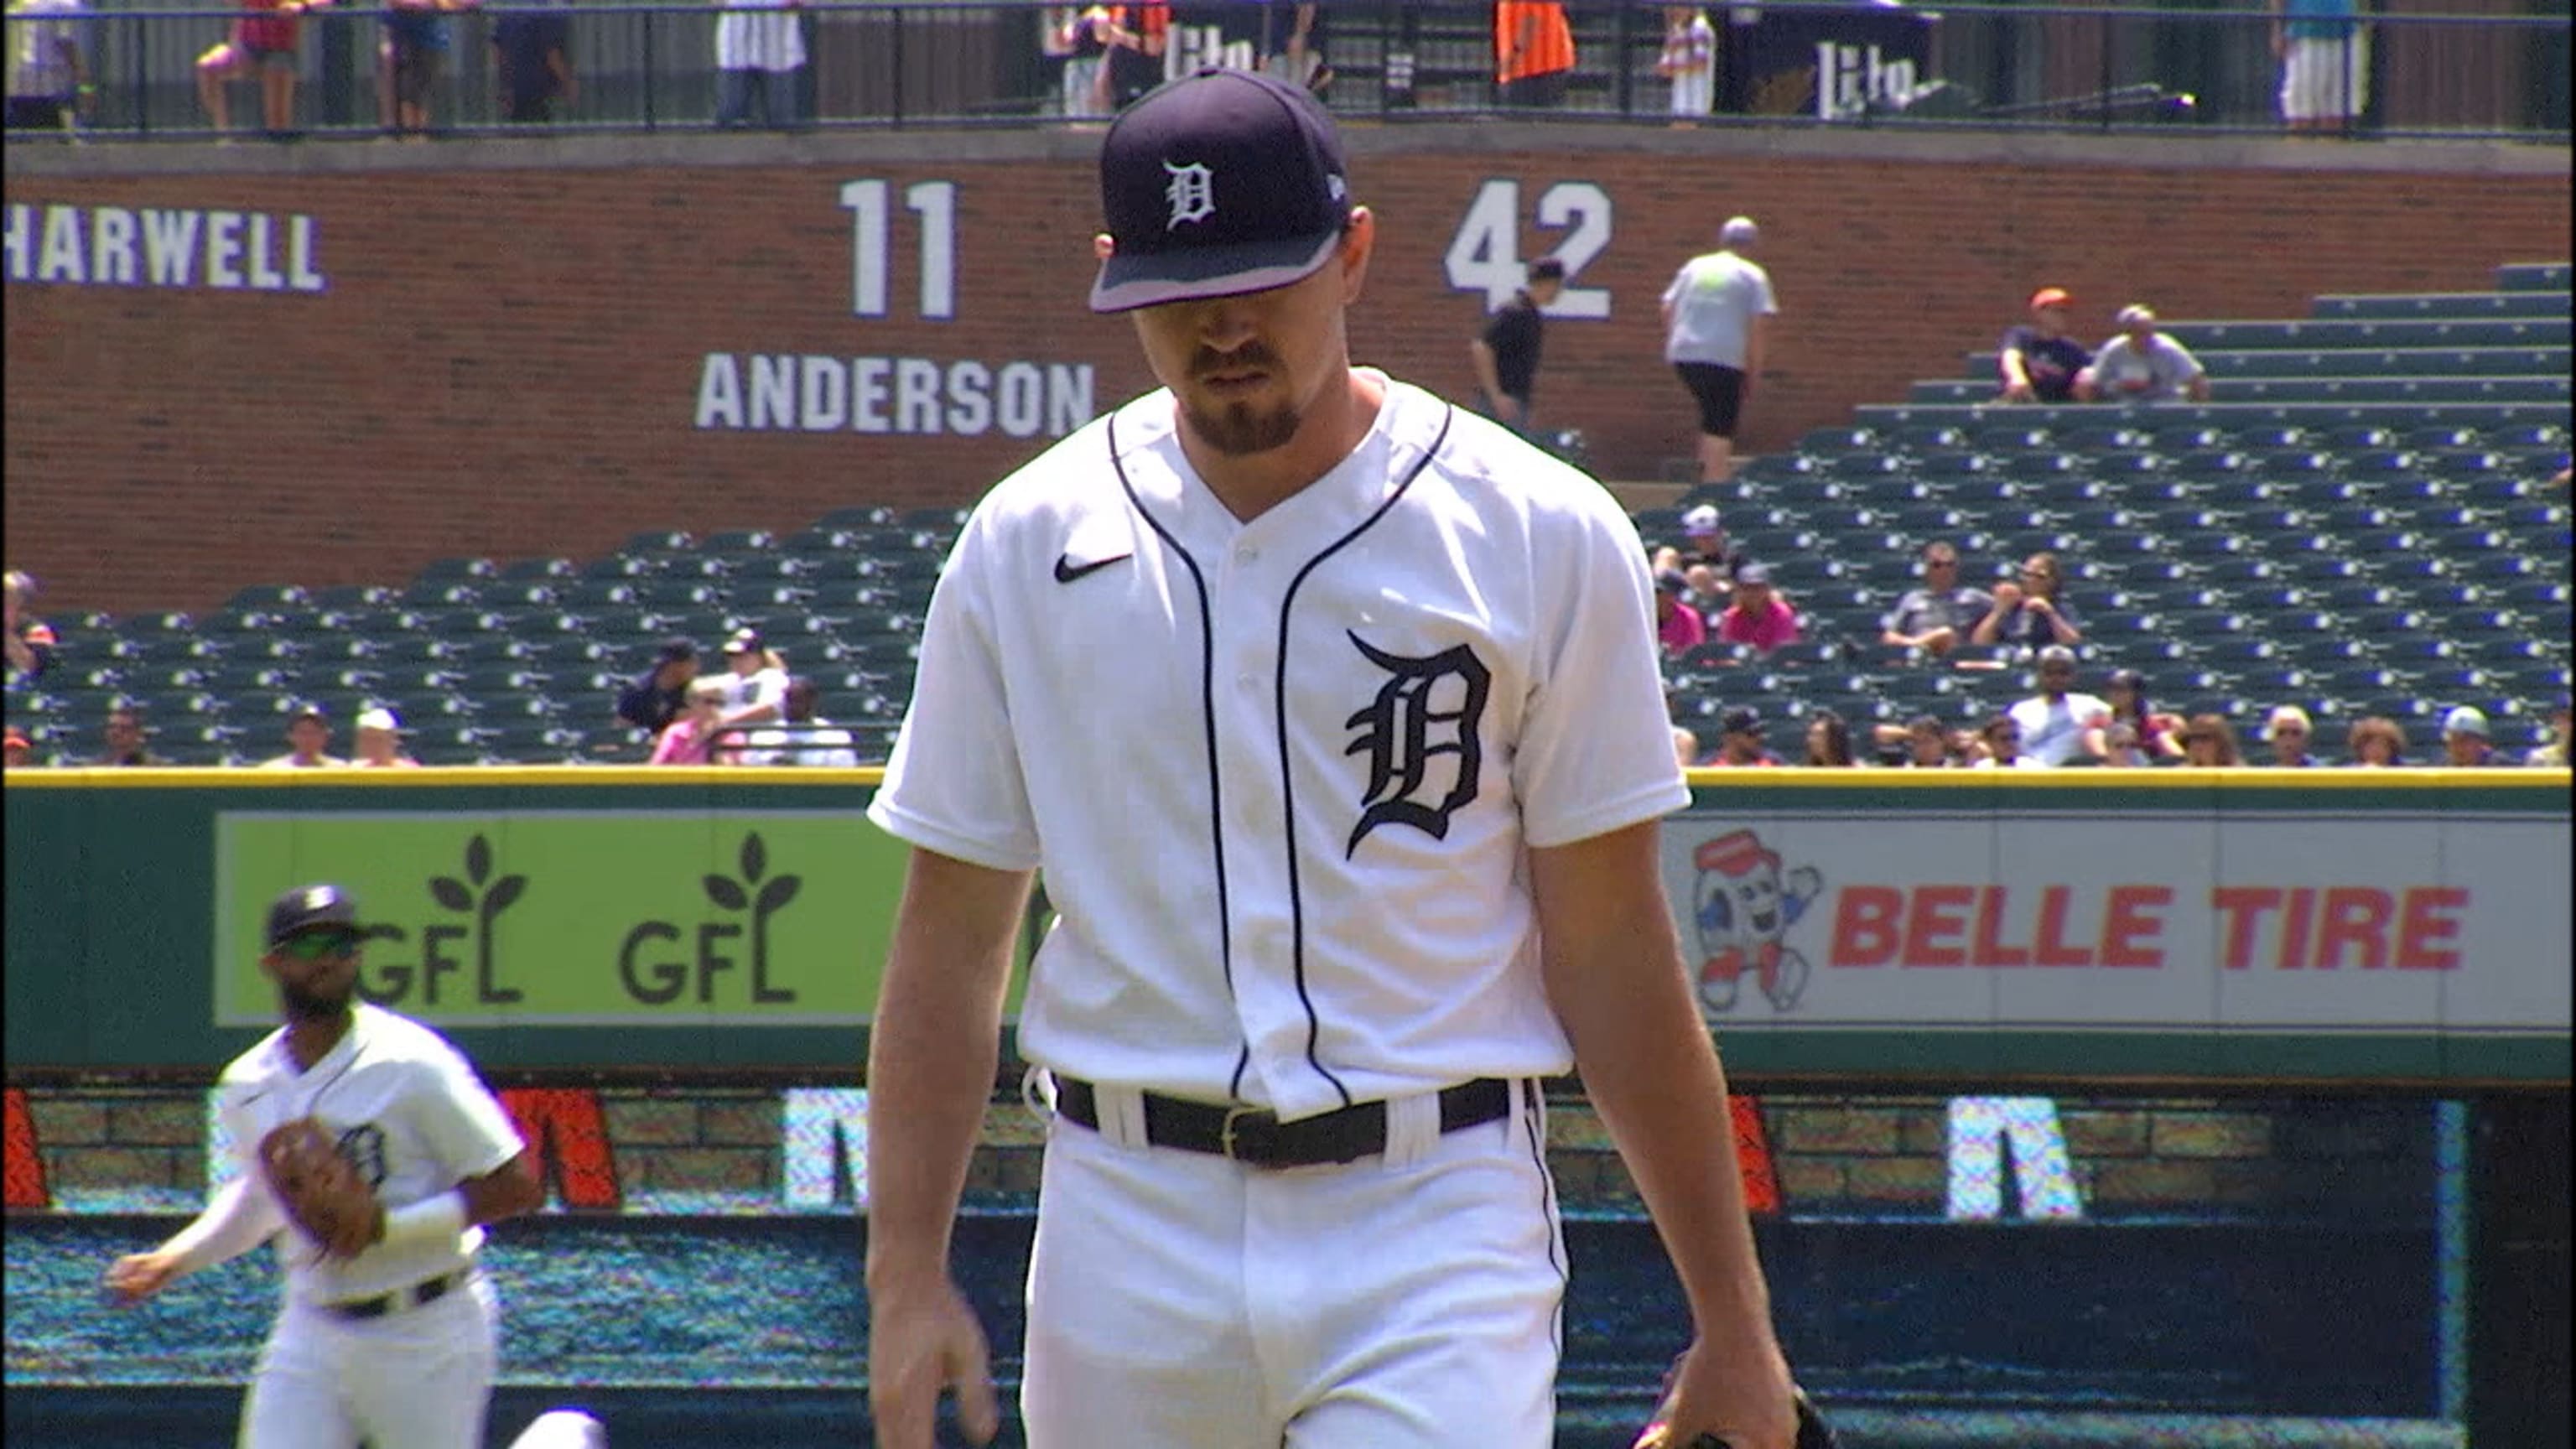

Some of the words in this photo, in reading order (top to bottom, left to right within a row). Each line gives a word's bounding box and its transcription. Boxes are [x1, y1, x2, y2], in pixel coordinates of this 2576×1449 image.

[839, 179, 954, 320] 11
[1444, 179, 1612, 319] 42
[695, 352, 1094, 438] ANDERSON
[1344, 627, 1491, 862] D
[354, 875, 527, 1005] GFL
[618, 873, 802, 1005] GFL
[1828, 885, 2175, 969] BELLE
[2210, 886, 2470, 970] TIRE
